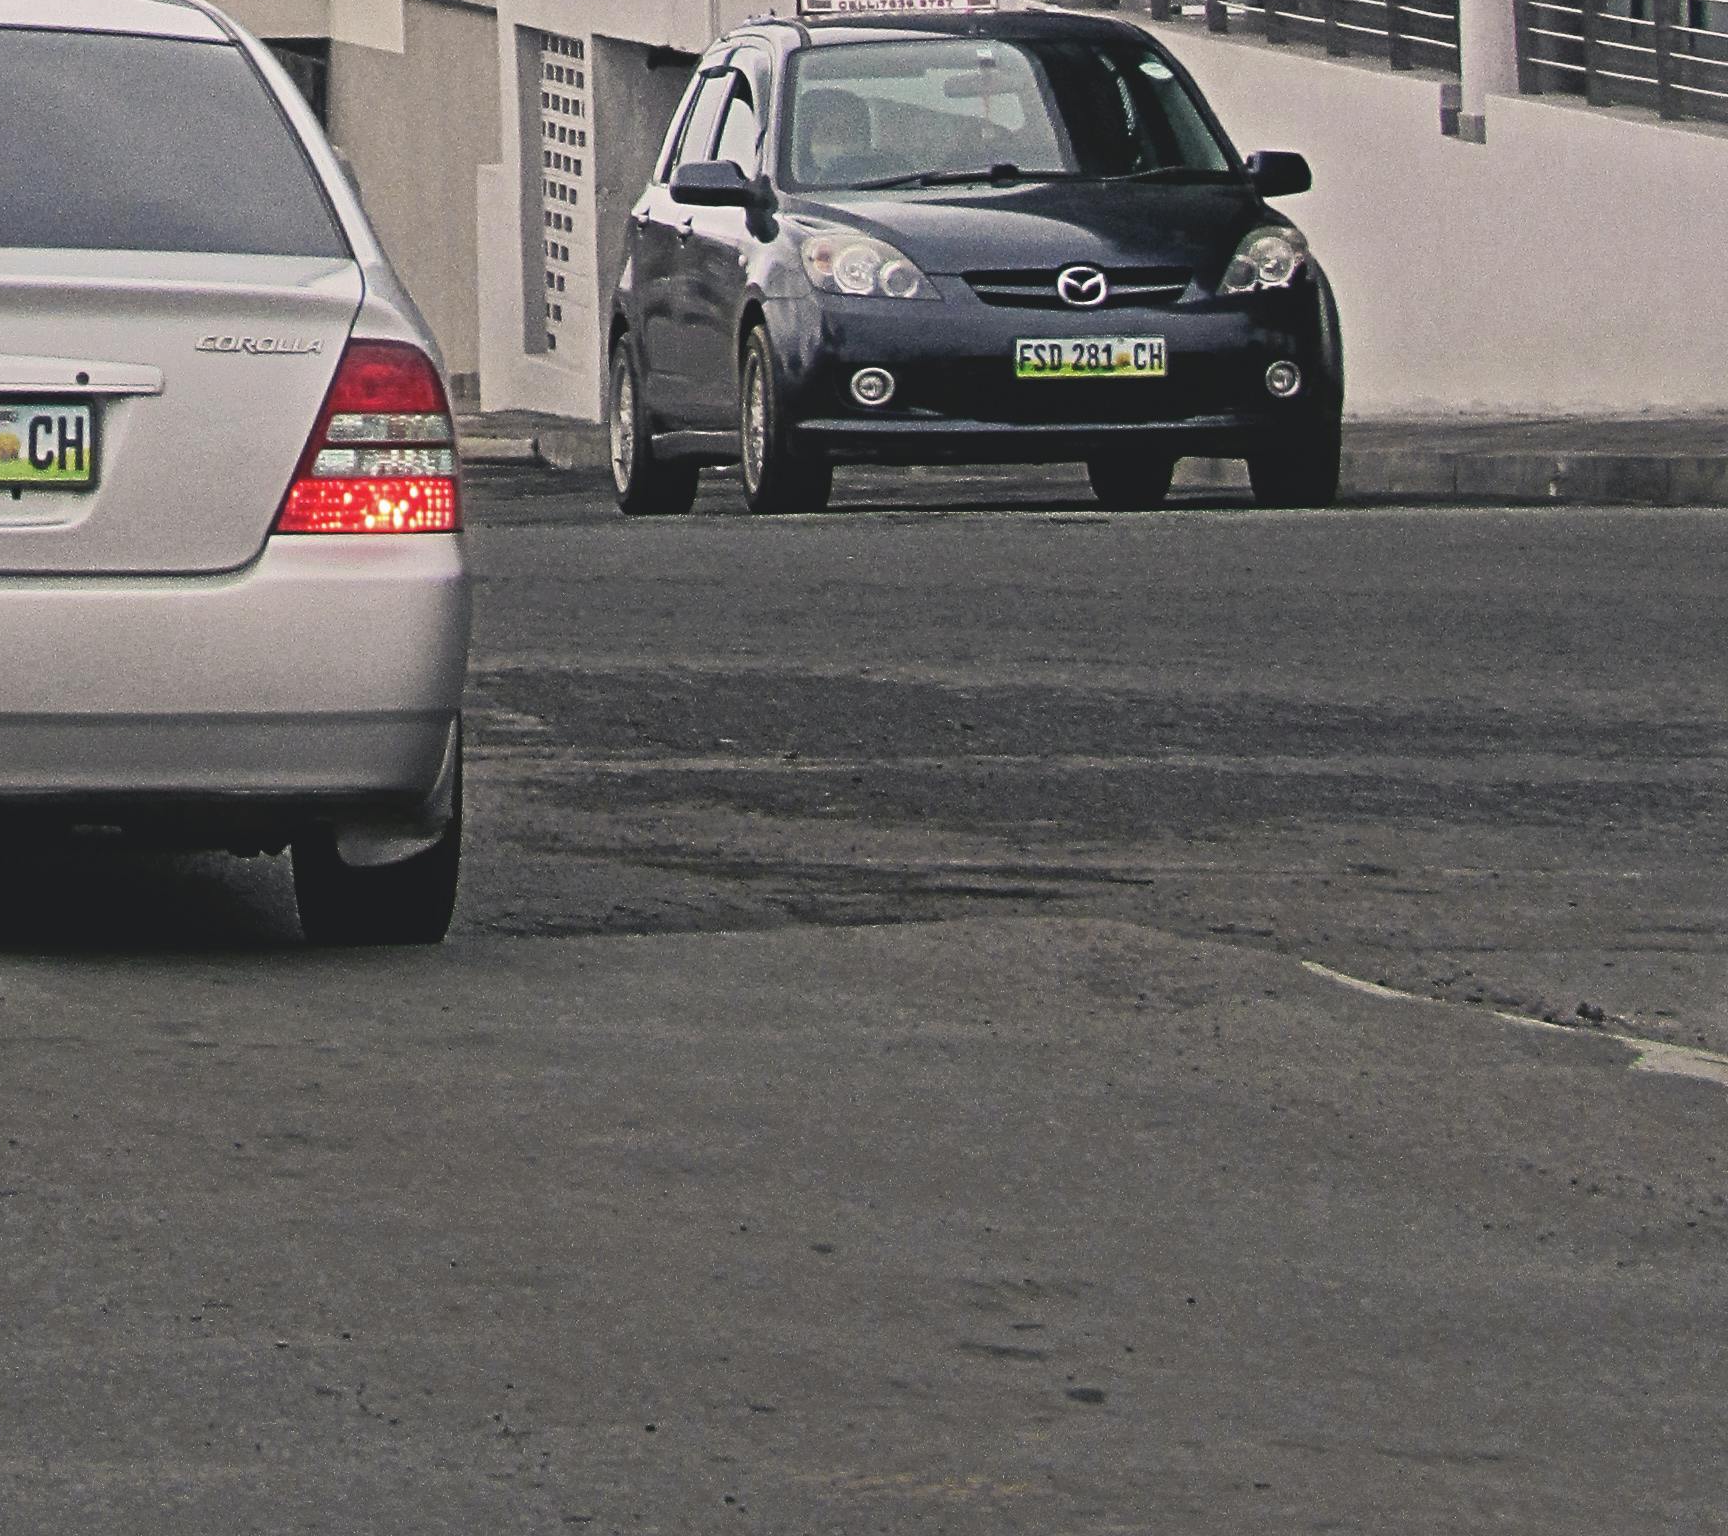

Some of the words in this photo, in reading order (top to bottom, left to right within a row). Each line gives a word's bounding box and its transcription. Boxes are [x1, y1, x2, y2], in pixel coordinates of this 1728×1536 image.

[195, 336, 322, 354] COROLLA
[1018, 343, 1063, 371] FSD
[1071, 343, 1114, 371] 281
[1133, 342, 1163, 370] CH
[28, 415, 84, 471] CH
